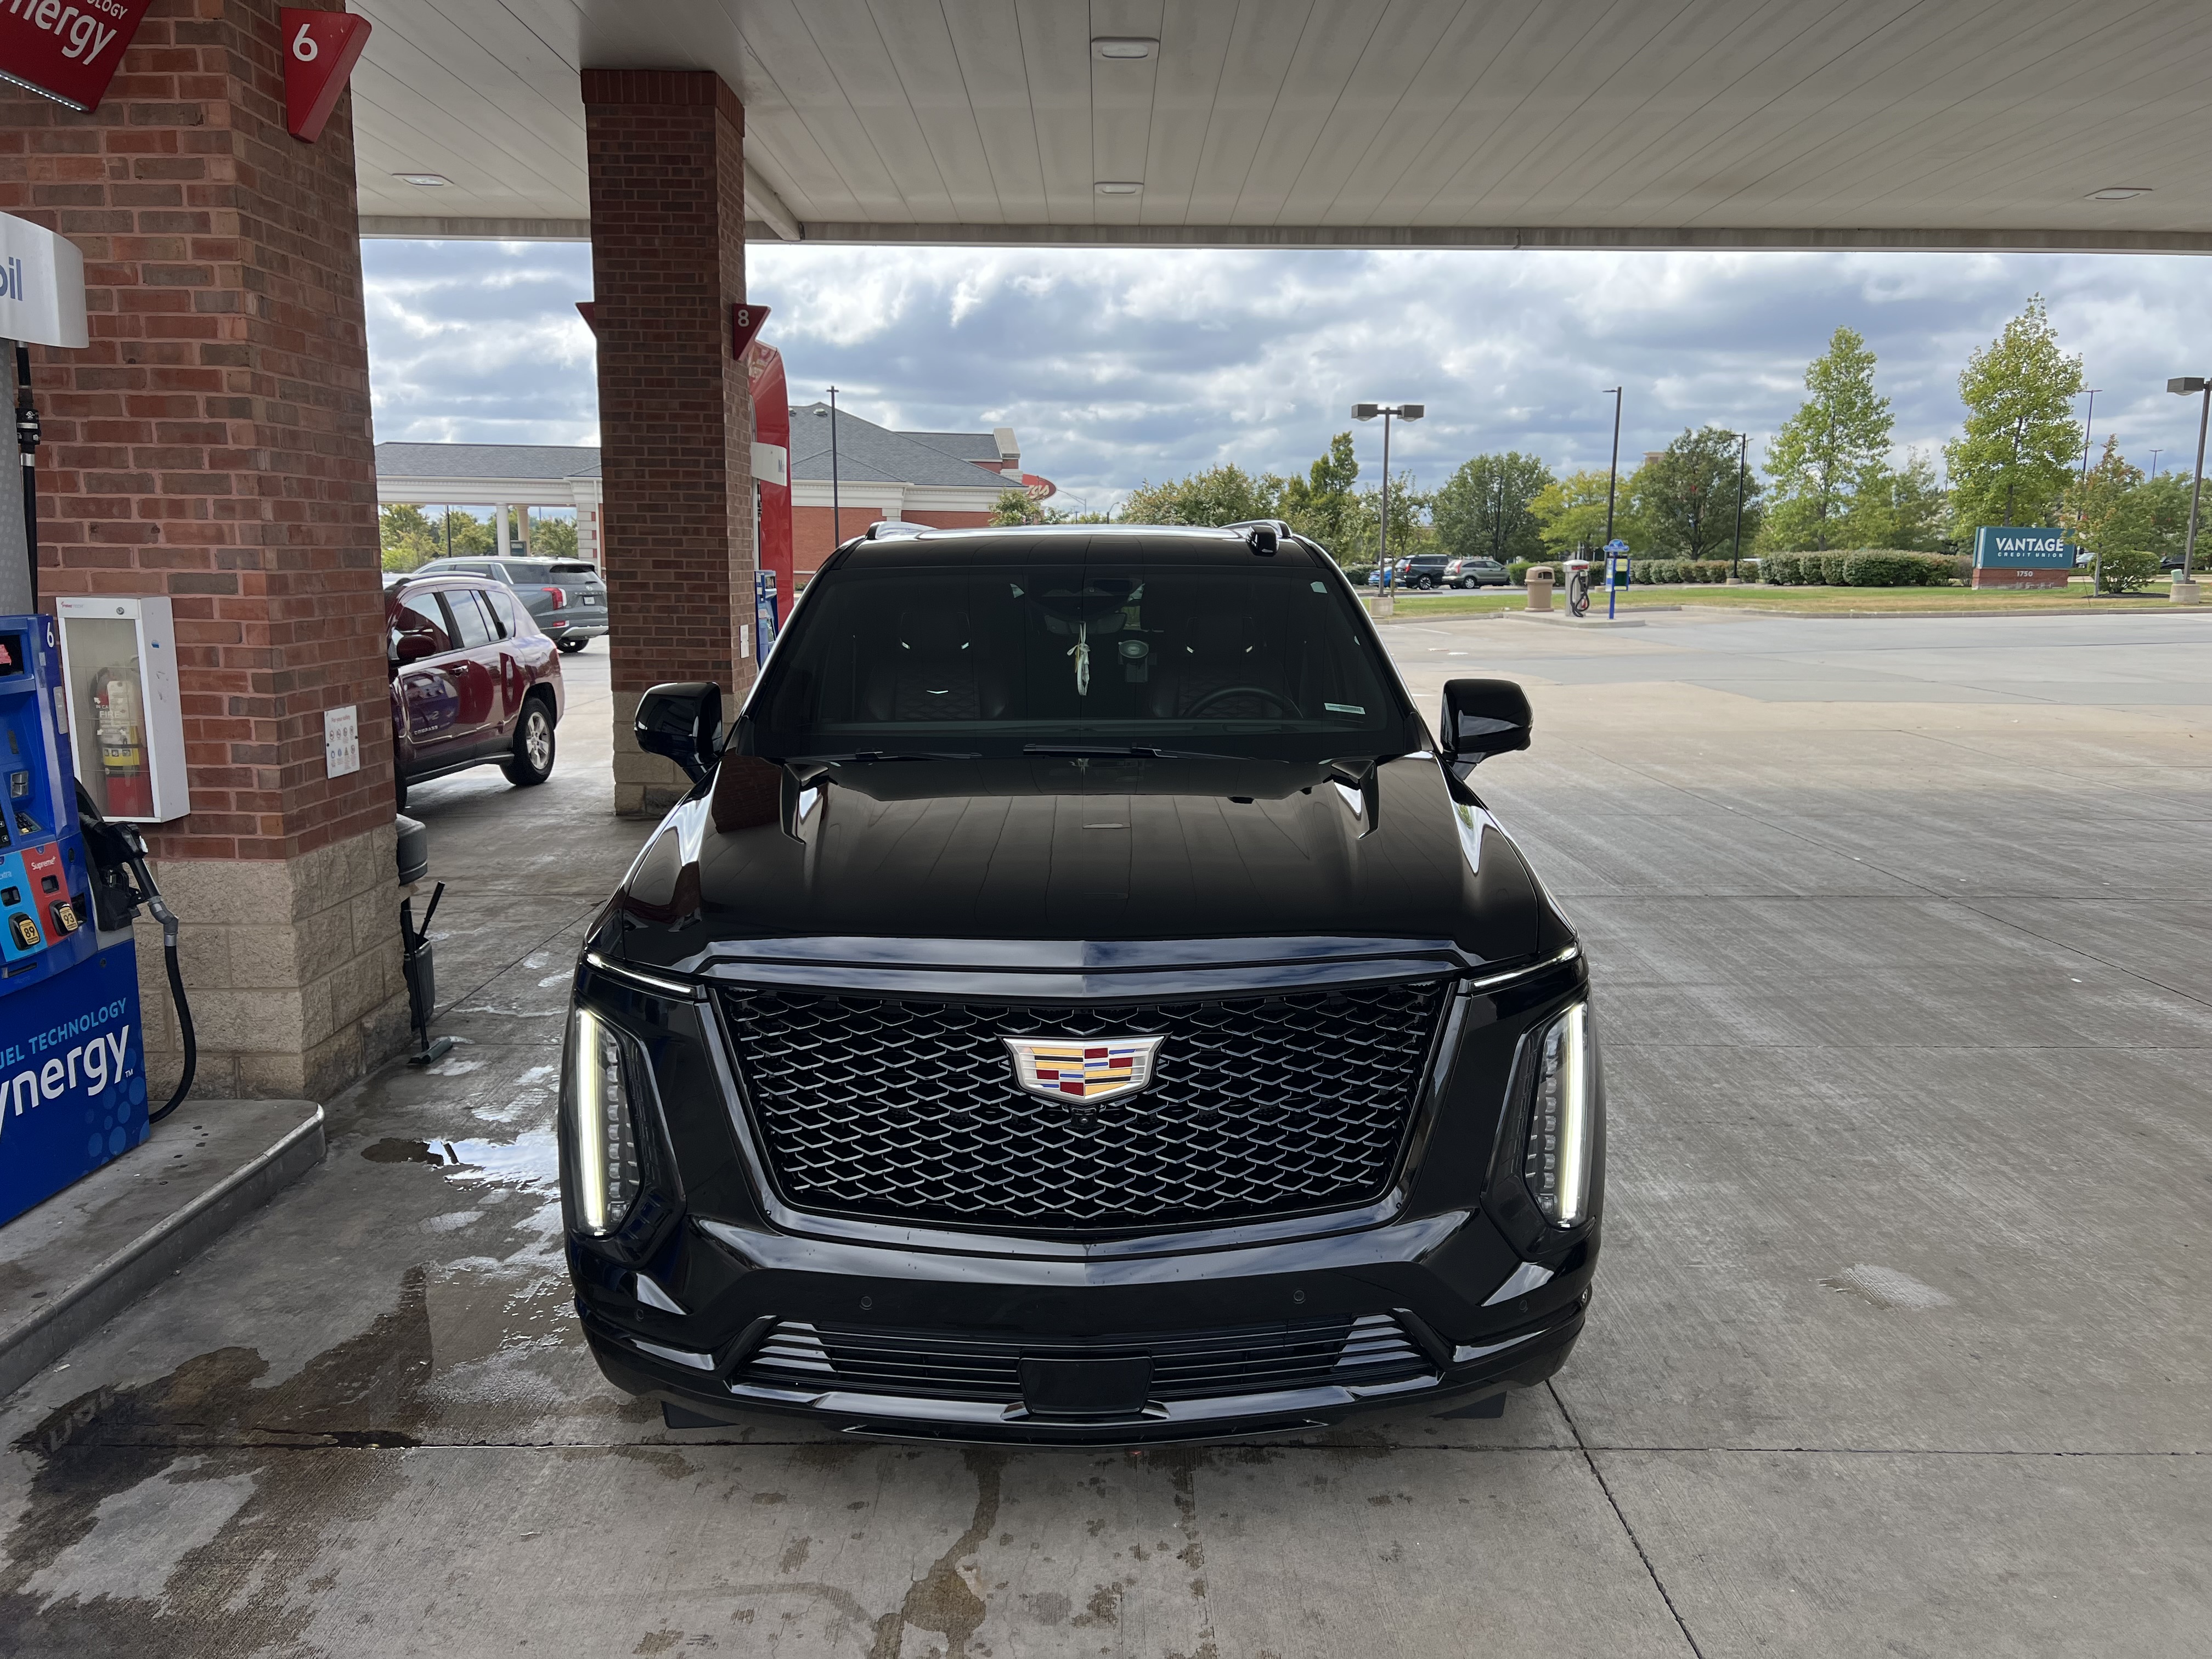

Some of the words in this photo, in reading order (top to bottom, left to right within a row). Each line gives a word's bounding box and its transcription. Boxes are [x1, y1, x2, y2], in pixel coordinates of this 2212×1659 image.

[87, 0, 128, 20] LOGY
[0, 0, 117, 65] nergy
[292, 23, 318, 61] 6
[737, 309, 749, 327] 8
[1995, 538, 2064, 552] VANTAGE
[47, 622, 54, 648] 6
[99, 710, 121, 719] FIRE
[64, 913, 74, 924] 93
[24, 926, 35, 938] 89
[29, 997, 126, 1054] TECHNOLOGY
